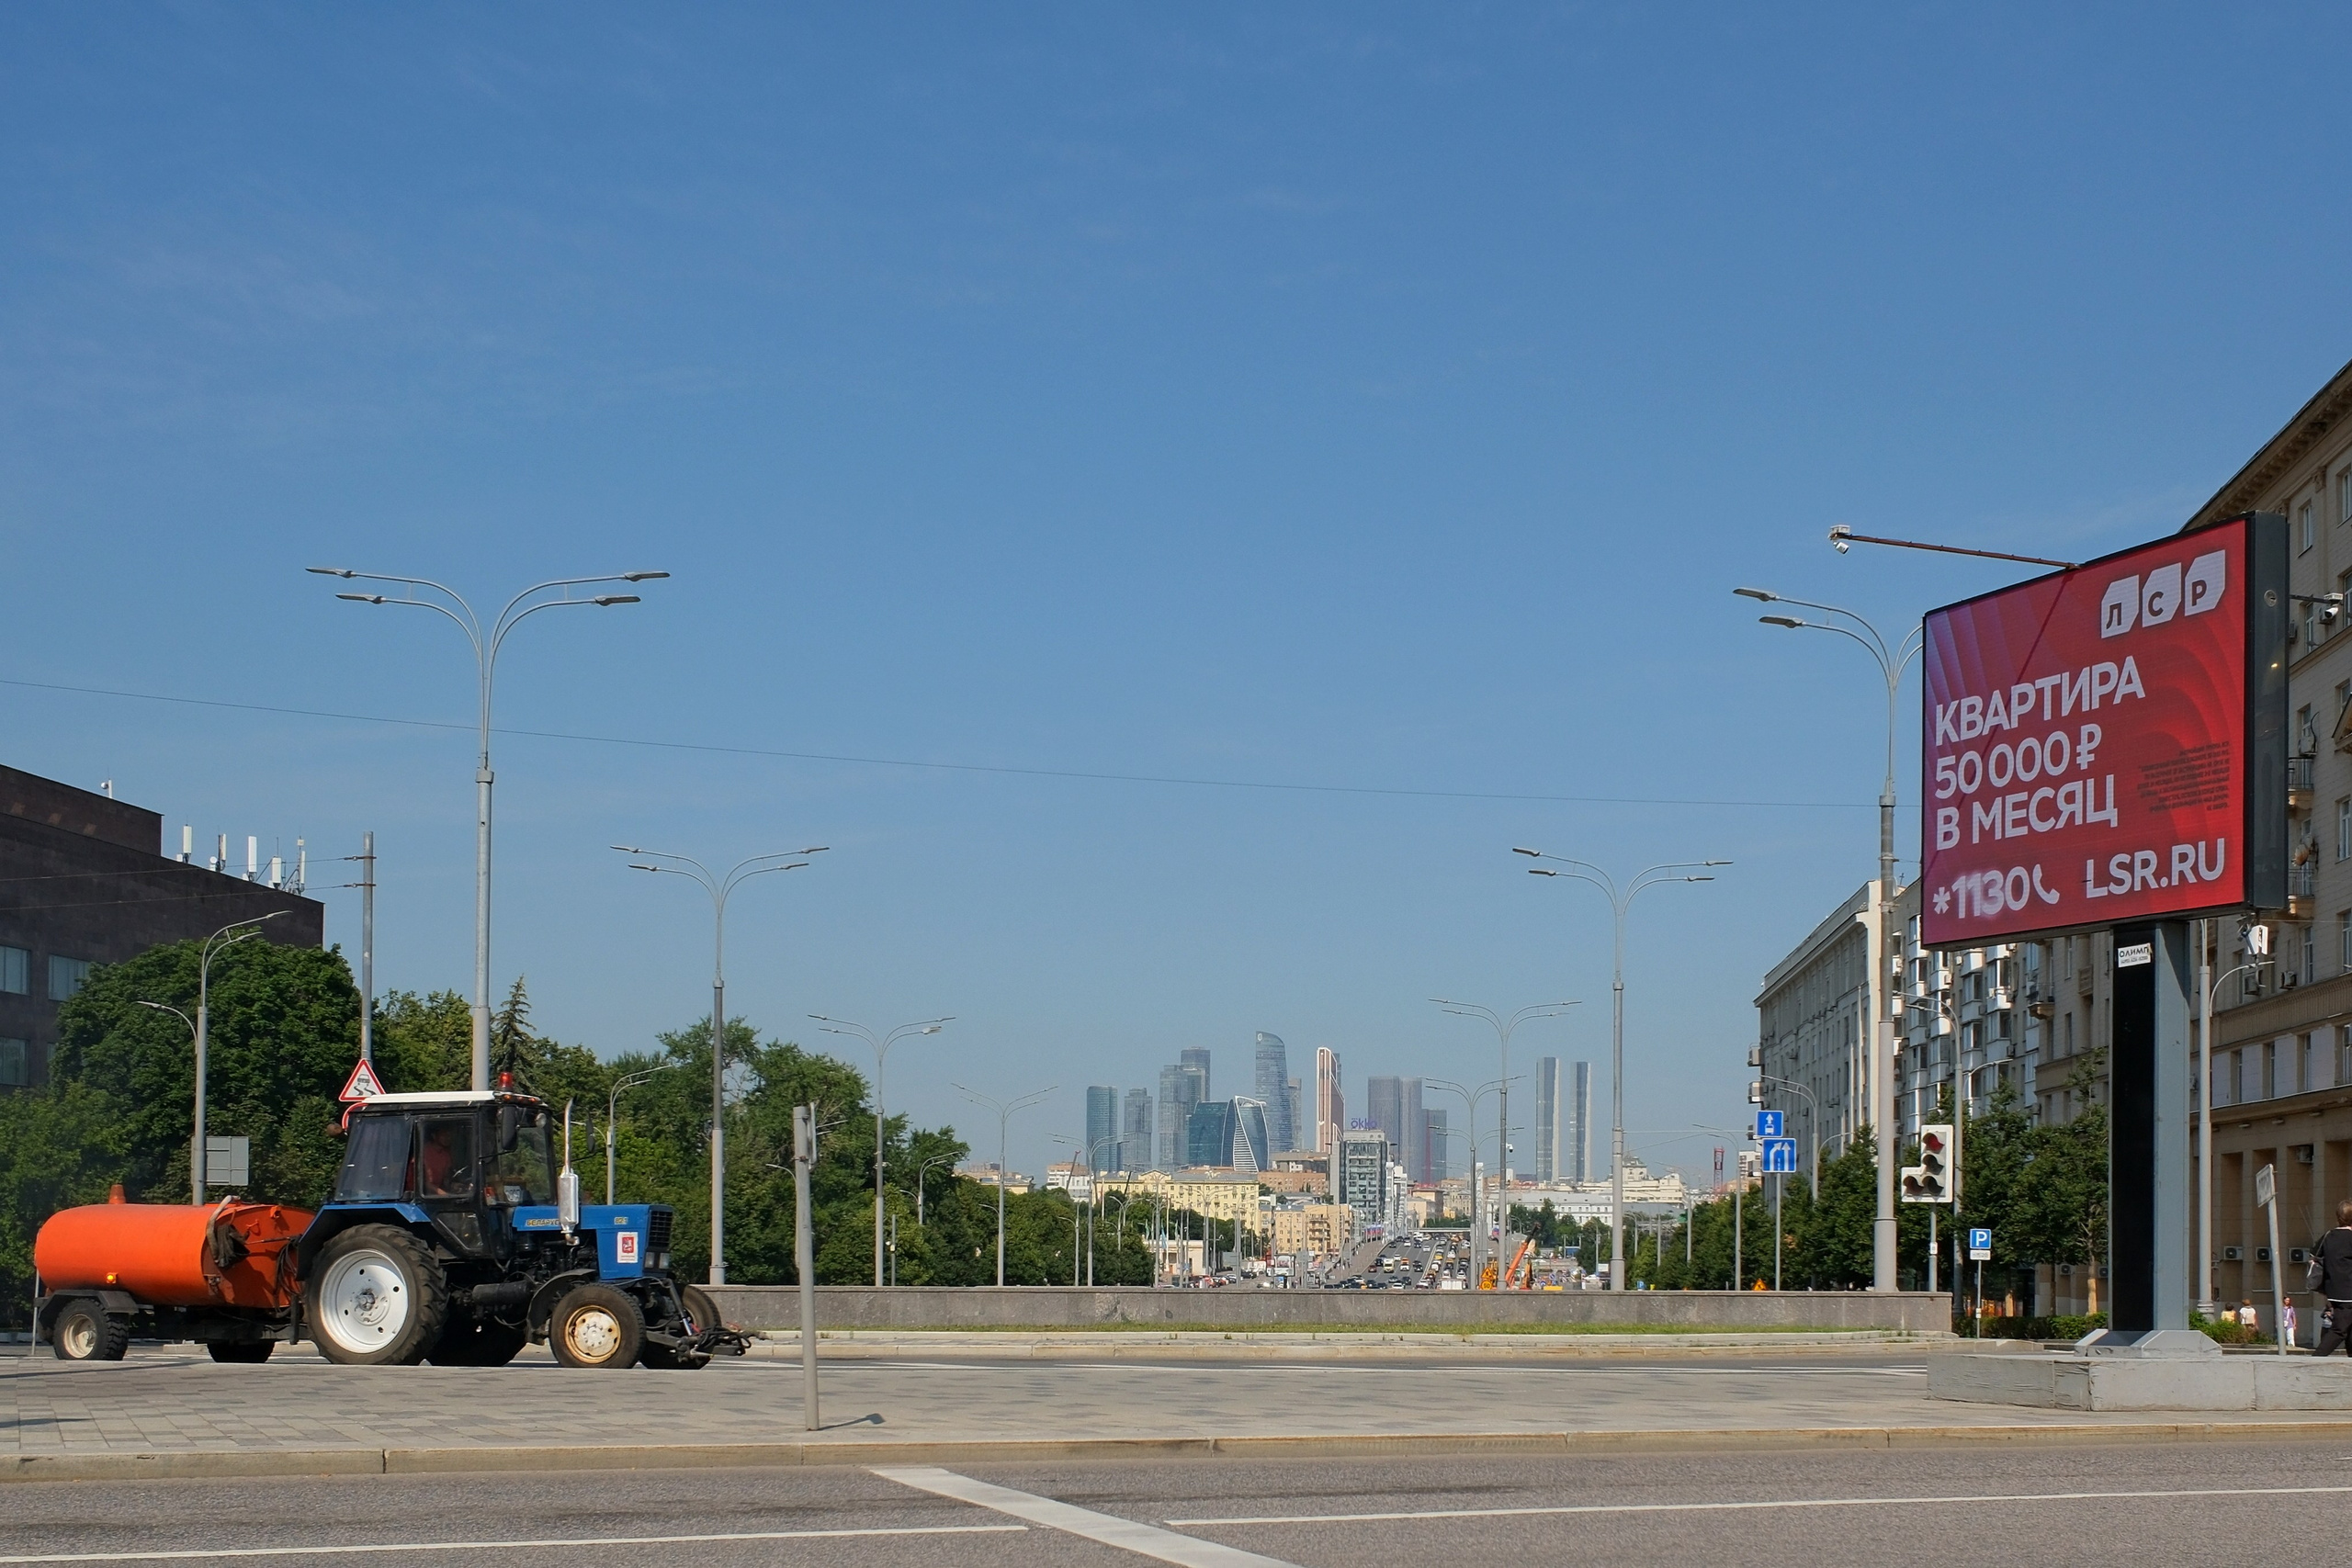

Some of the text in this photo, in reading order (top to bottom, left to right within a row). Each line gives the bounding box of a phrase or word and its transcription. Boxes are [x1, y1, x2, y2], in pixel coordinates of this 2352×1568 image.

[1935, 655, 2146, 747] КВАРТИРА
[1937, 806, 1961, 851] В
[1972, 773, 2118, 844] МЕСЯЦ
[2086, 838, 2225, 898] LSR.RU
[2119, 946, 2149, 958] ОЛИМП
[1975, 1231, 1987, 1247] P
